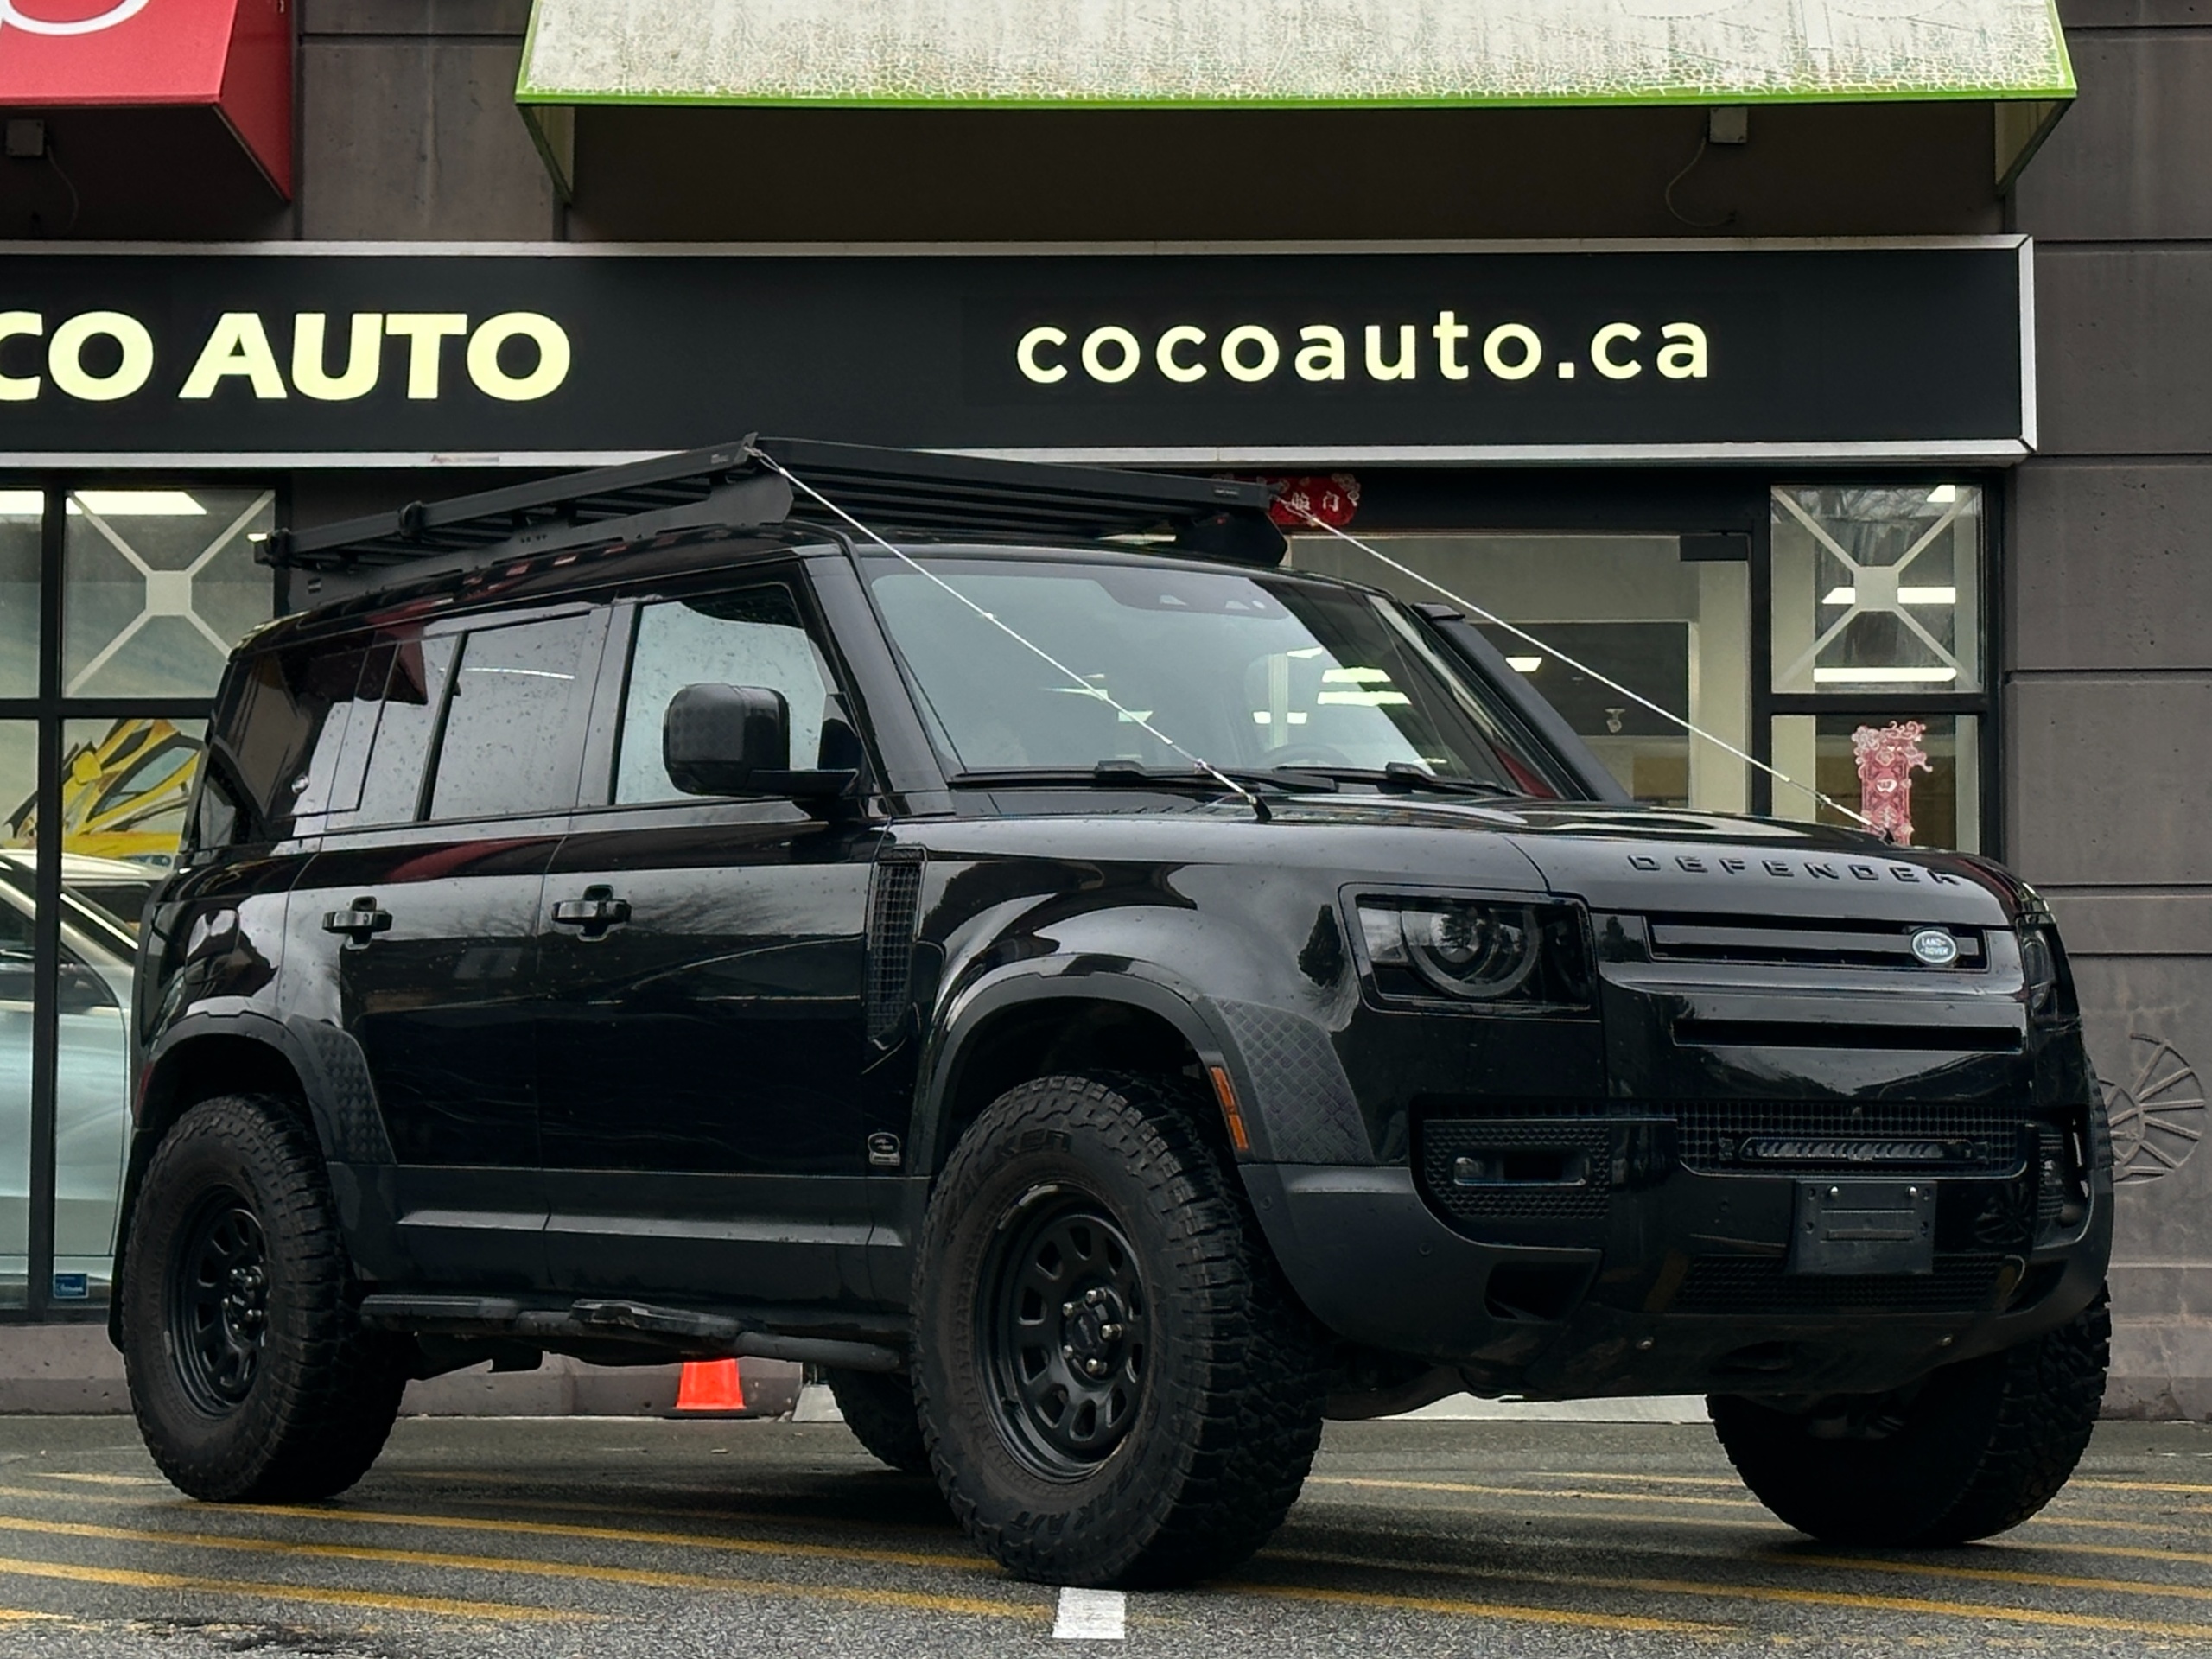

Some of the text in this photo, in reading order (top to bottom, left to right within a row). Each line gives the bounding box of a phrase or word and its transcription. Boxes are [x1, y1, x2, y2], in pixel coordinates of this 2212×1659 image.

[179, 312, 570, 401] AUTO
[1018, 311, 1707, 383] cocoauto.ca
[1628, 854, 1961, 886] DEFENDER
